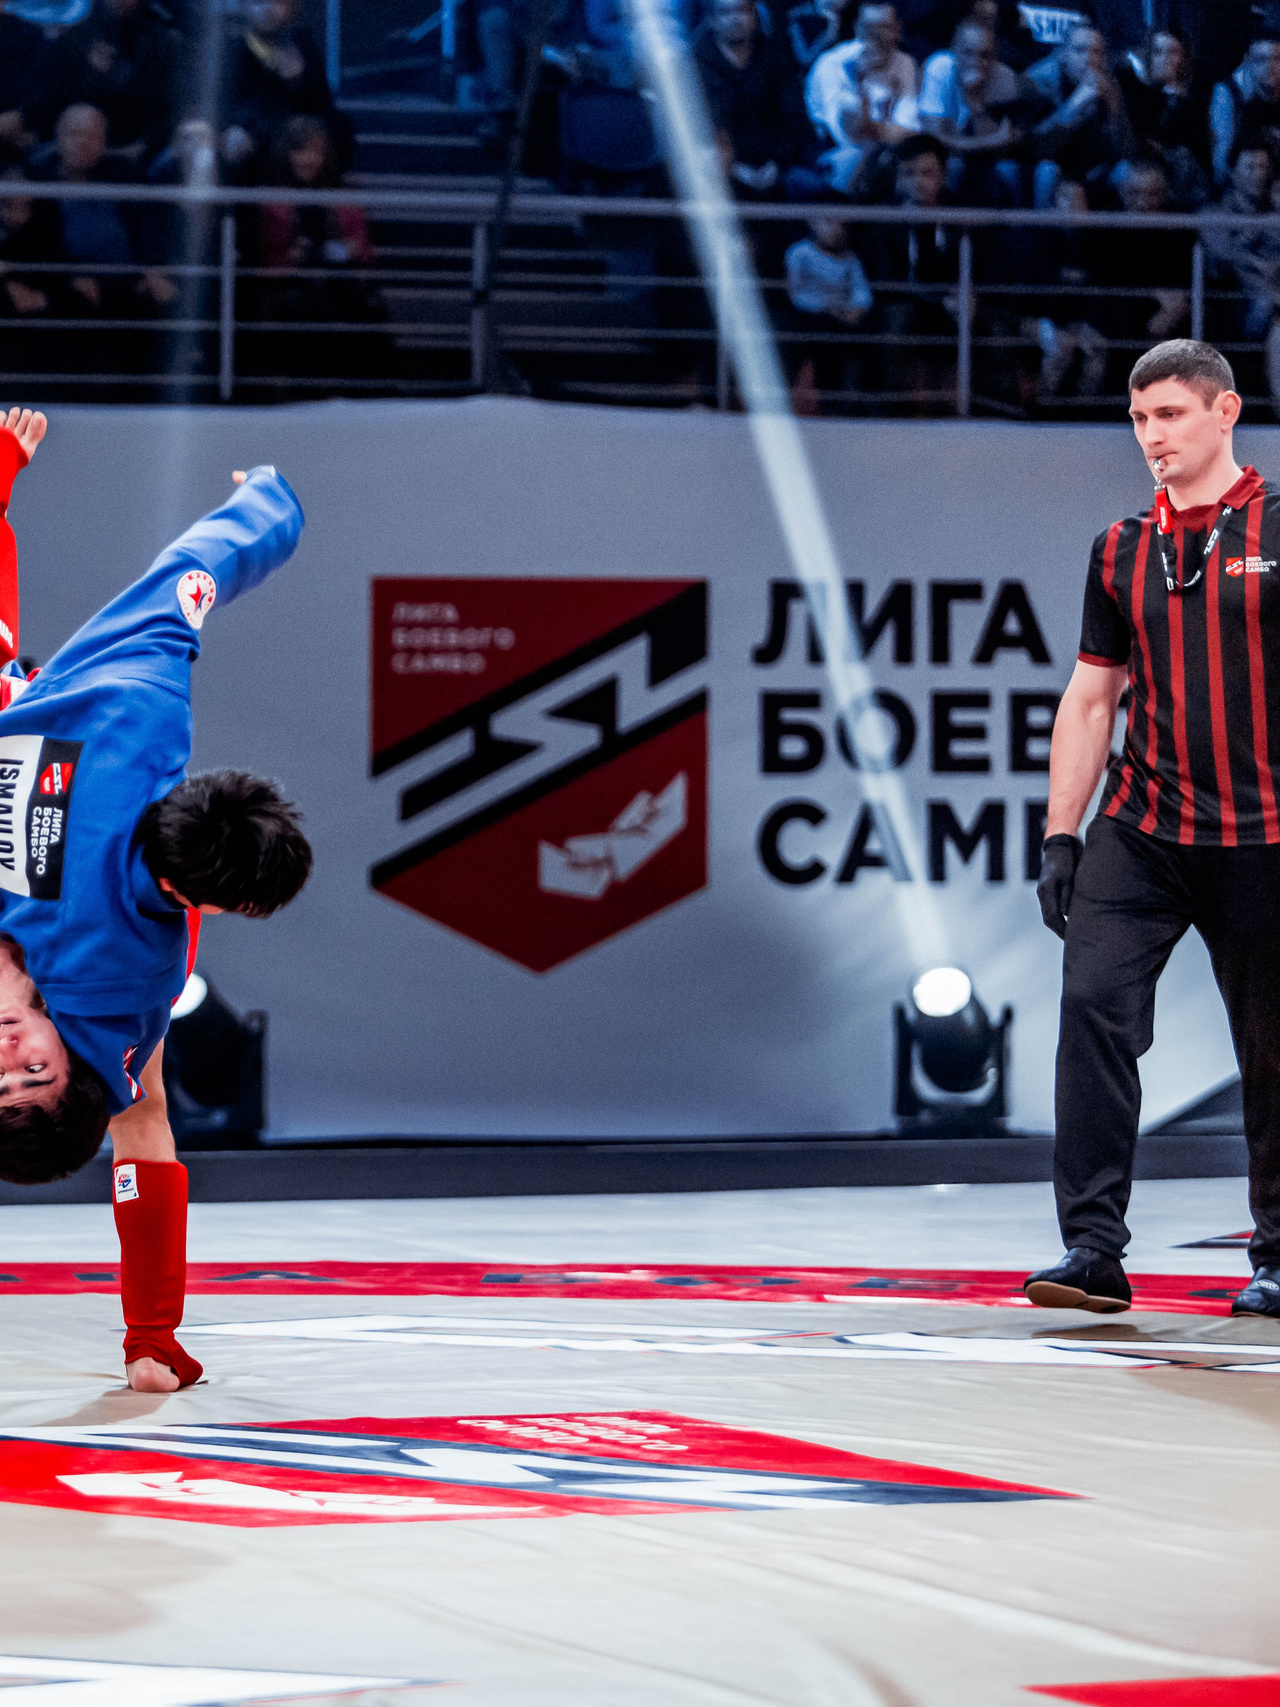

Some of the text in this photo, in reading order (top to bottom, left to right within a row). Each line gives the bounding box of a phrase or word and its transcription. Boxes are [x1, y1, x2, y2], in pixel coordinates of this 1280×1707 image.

[392, 602, 460, 623] ЛИГА
[392, 627, 516, 650] БОЕВОГО
[751, 579, 1051, 665] ЛИГА
[392, 652, 487, 675] САМБО
[760, 690, 1062, 775] БОЕВ
[30, 806, 42, 858] САМБО
[36, 806, 53, 875] БОЕВОГО
[49, 807, 63, 844] ЛИГА
[757, 799, 1048, 885] САМ
